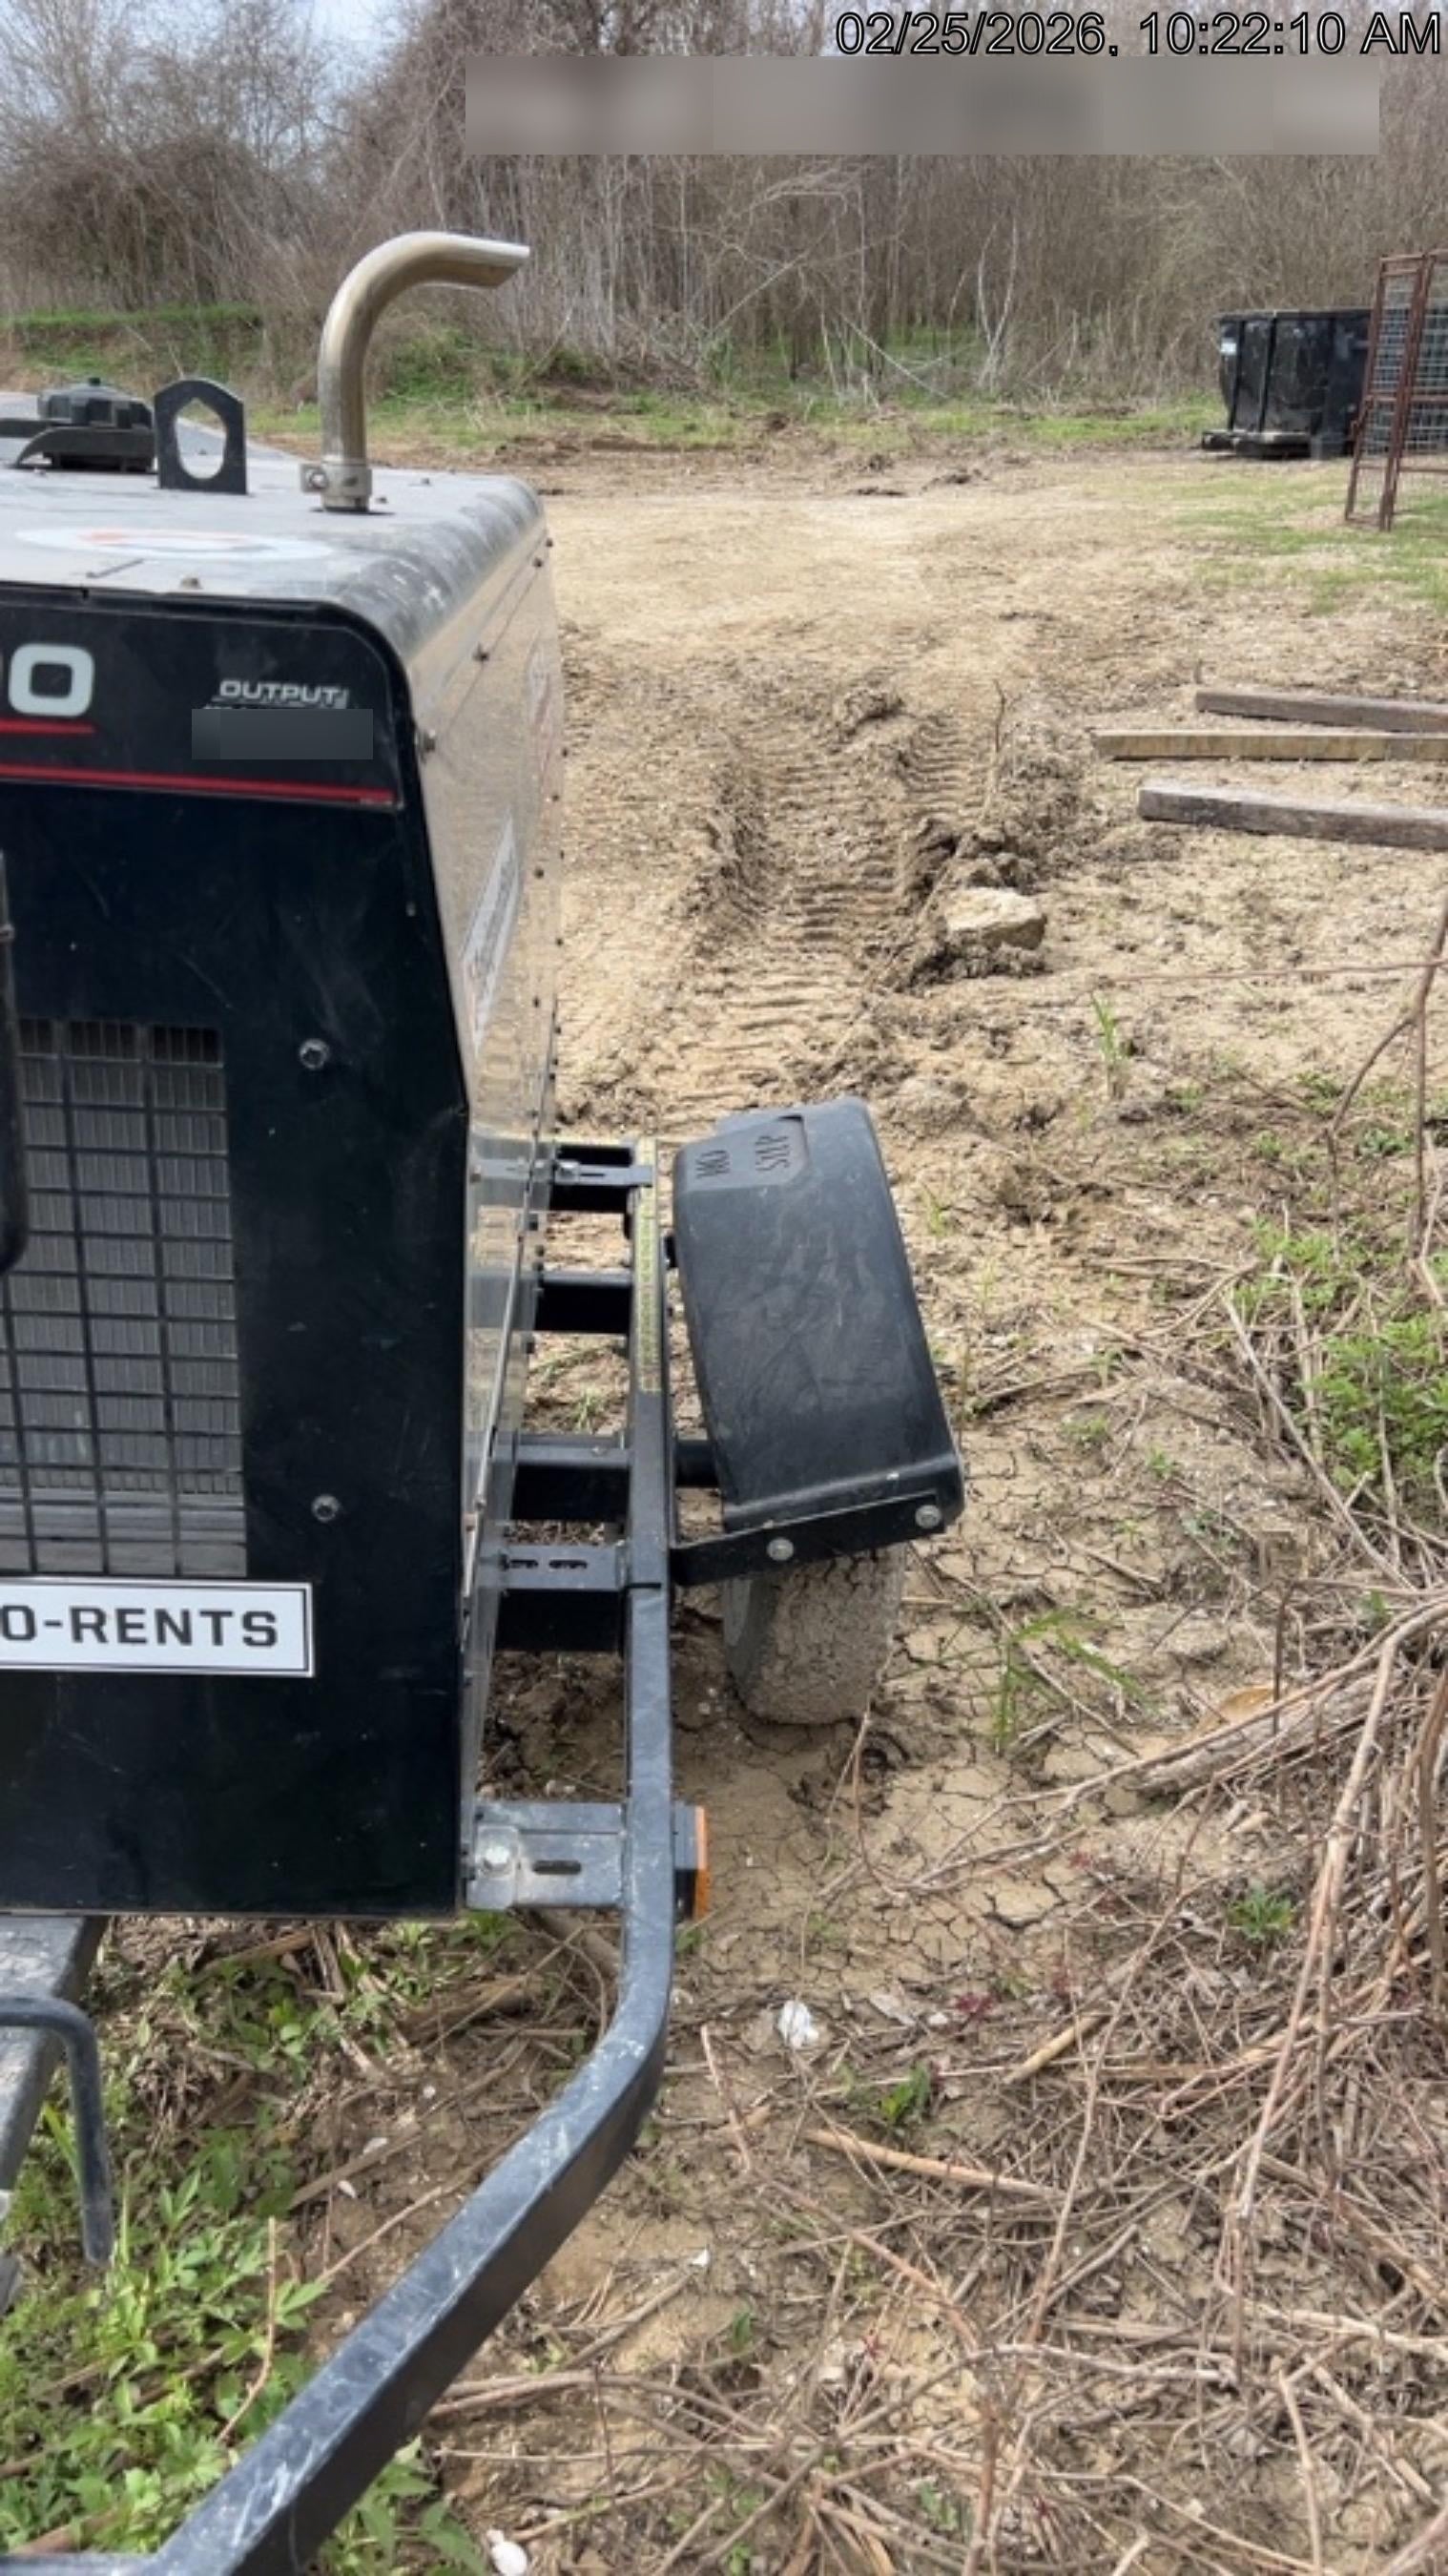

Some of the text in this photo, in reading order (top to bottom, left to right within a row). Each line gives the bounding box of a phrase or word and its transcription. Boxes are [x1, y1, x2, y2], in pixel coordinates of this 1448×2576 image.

[0, 642, 94, 717] 0
[219, 678, 341, 705] OUTPUT
[0, 1604, 278, 1648] O-RENTS
